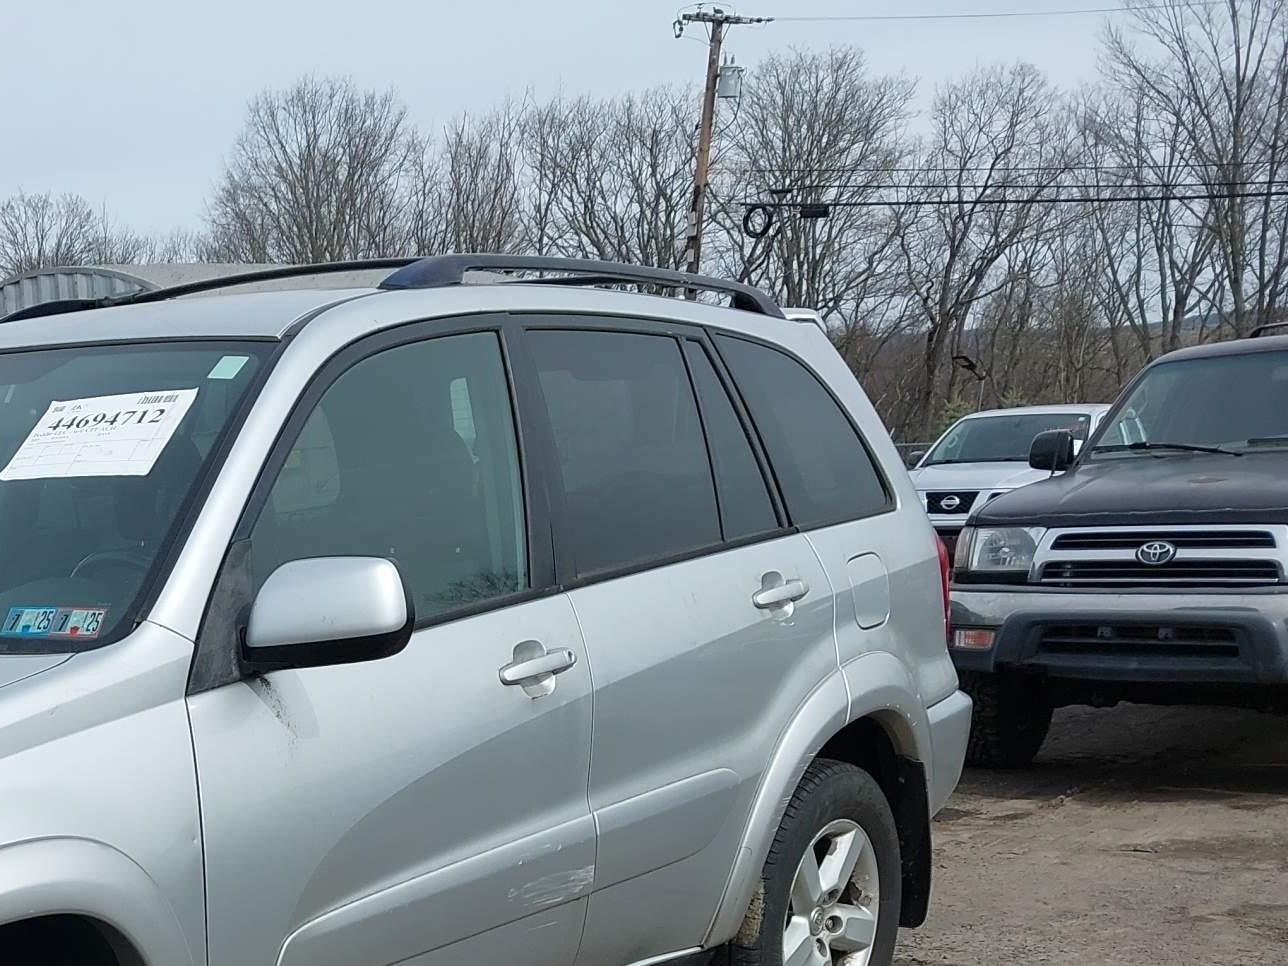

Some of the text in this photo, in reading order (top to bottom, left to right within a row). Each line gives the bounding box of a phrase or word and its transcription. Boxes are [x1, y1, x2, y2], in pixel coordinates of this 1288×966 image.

[48, 408, 166, 431] 44694712
[37, 611, 54, 630] 25
[85, 612, 103, 632] 25
